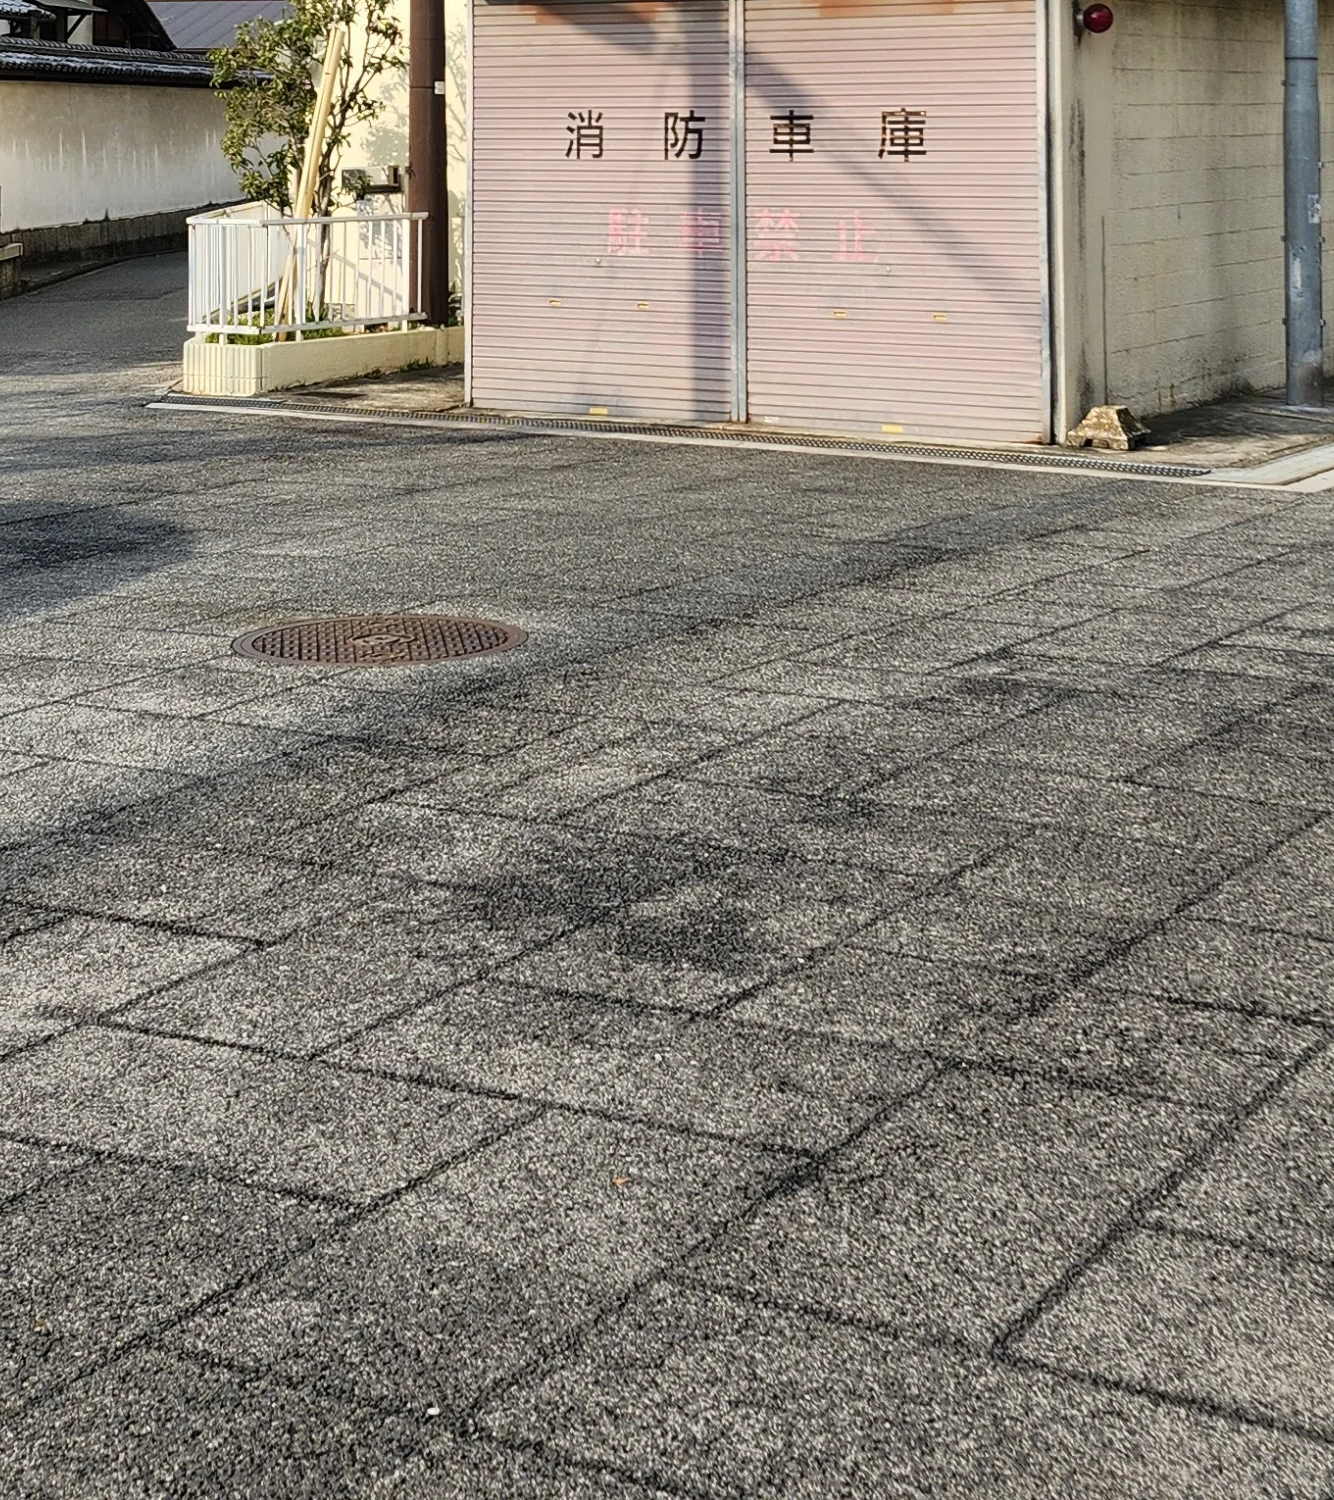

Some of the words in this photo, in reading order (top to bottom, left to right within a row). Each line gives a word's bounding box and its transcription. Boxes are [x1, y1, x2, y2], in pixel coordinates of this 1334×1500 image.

[565, 108, 928, 162] 消防車庫
[607, 207, 880, 262] 駐車禁止
